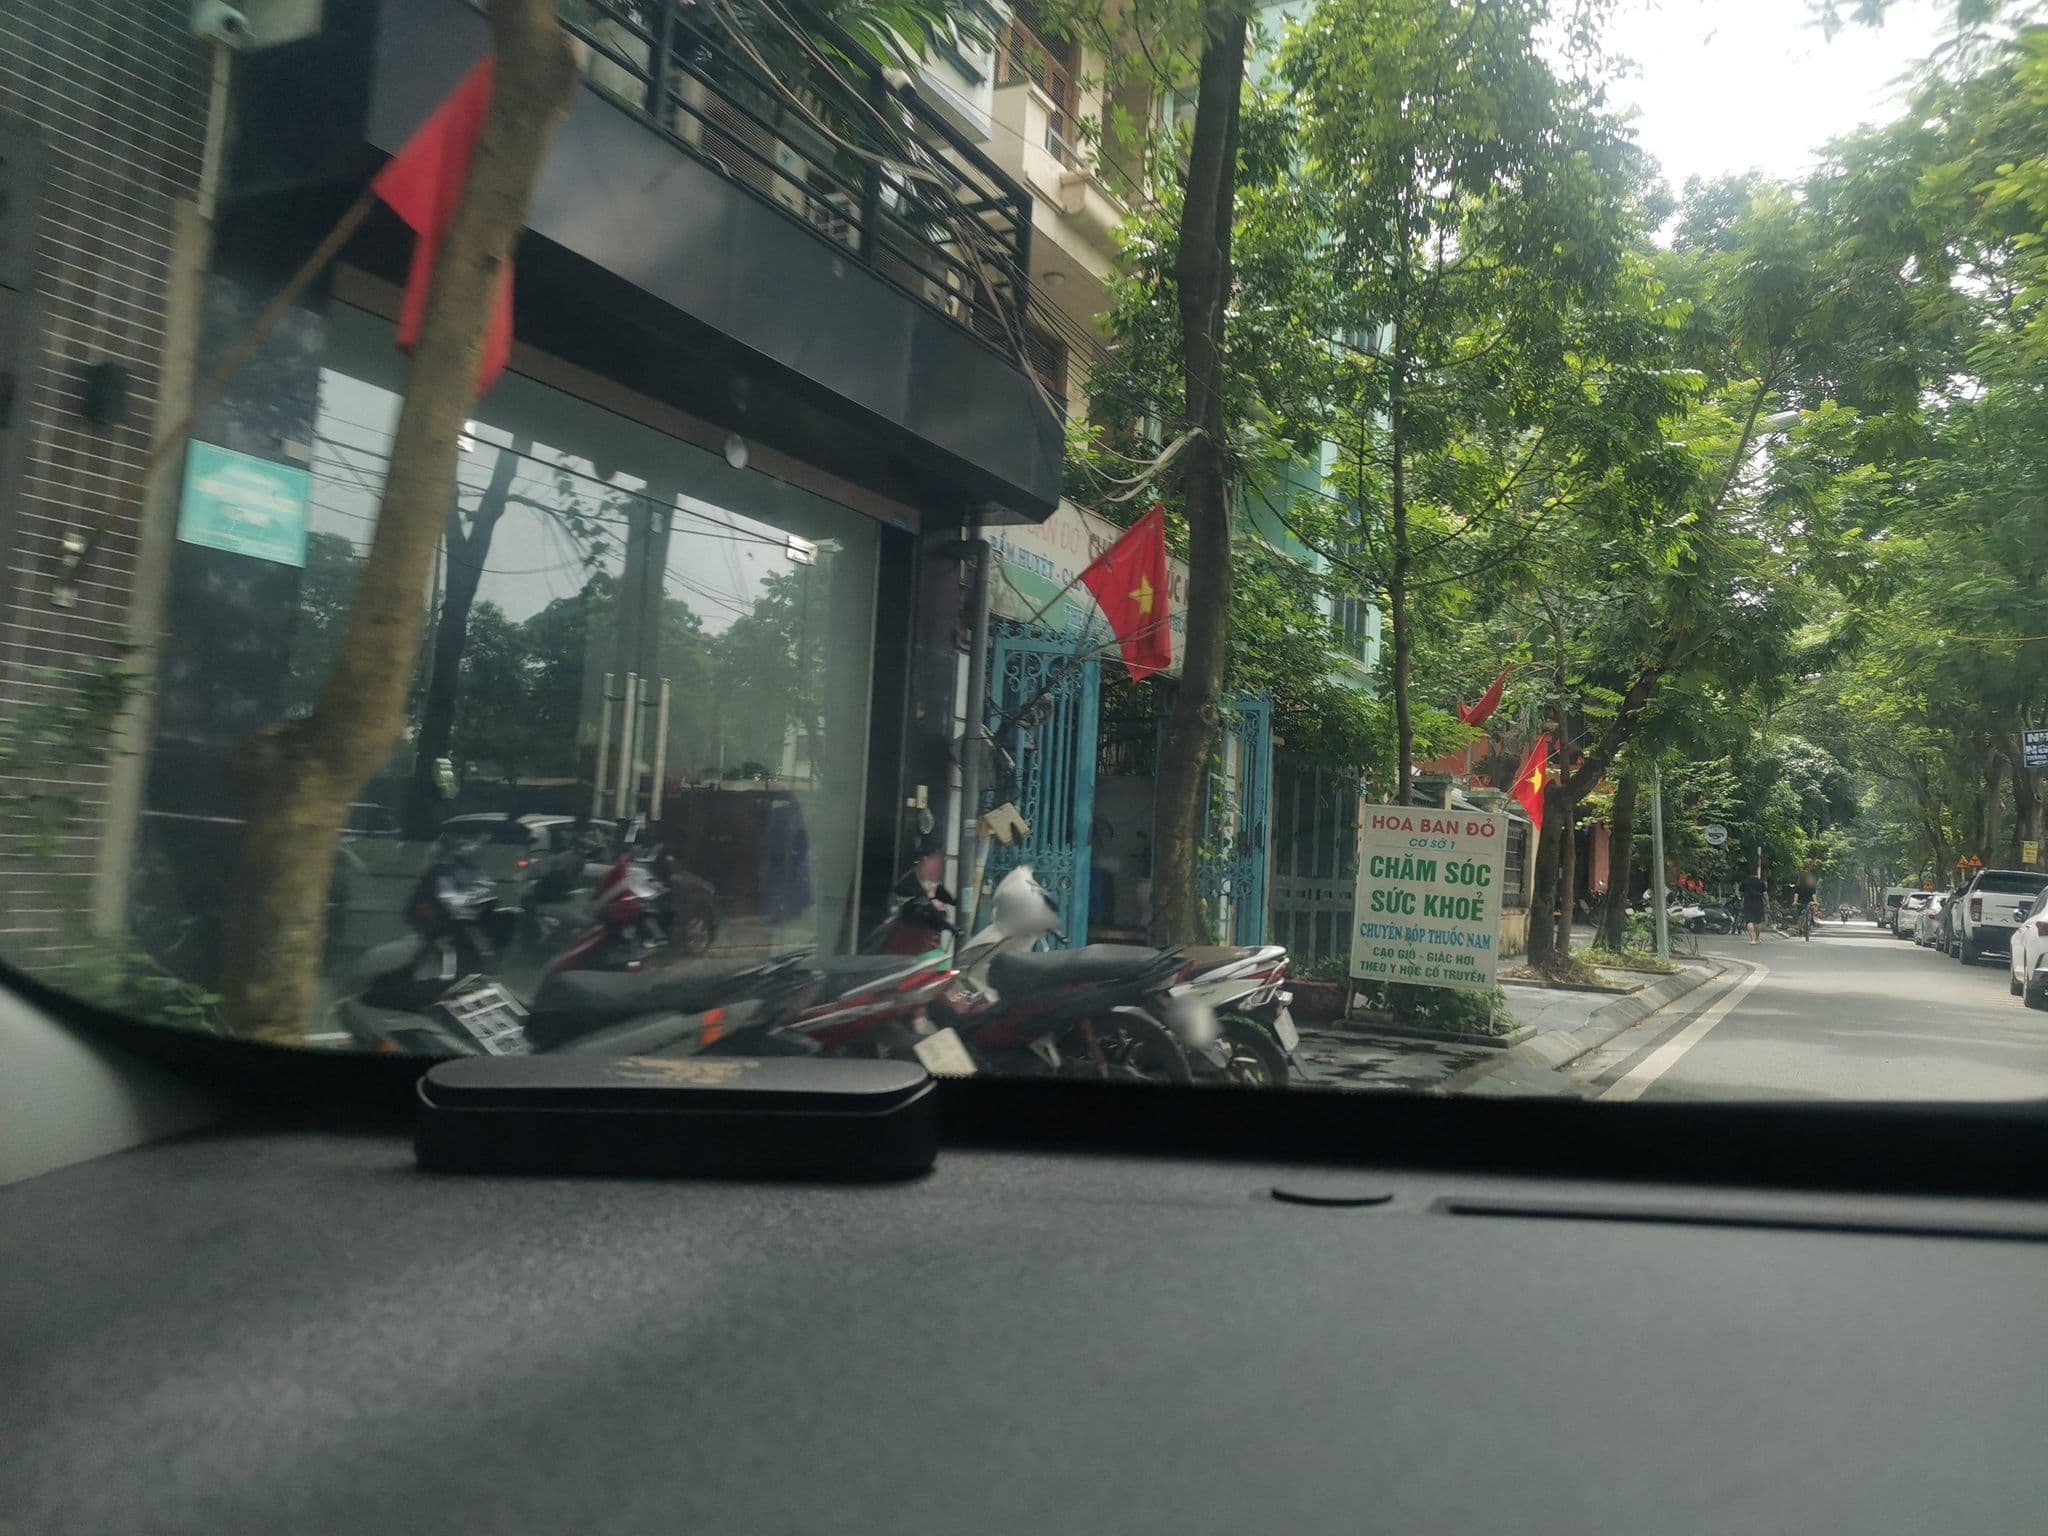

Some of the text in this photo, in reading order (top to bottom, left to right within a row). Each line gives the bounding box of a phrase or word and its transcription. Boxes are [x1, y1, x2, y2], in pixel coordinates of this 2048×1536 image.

[1372, 815, 1496, 837] HOA BAN ĐỎ
[1409, 837, 1456, 849] CƠ SỞ 1
[1370, 853, 1491, 887] CHĂM SÓC
[1371, 887, 1485, 922] SỨC KHOẺ
[1360, 922, 1491, 949] CHUYÊN BÓP THUỐC NAM
[1373, 946, 1394, 959] CẠO
[1397, 943, 1416, 960] GIÓ
[1427, 951, 1452, 964] GIÁC
[1455, 955, 1475, 966] HƠI
[1360, 960, 1485, 983] THEO Y HỌC CỔ TRUYỀN
